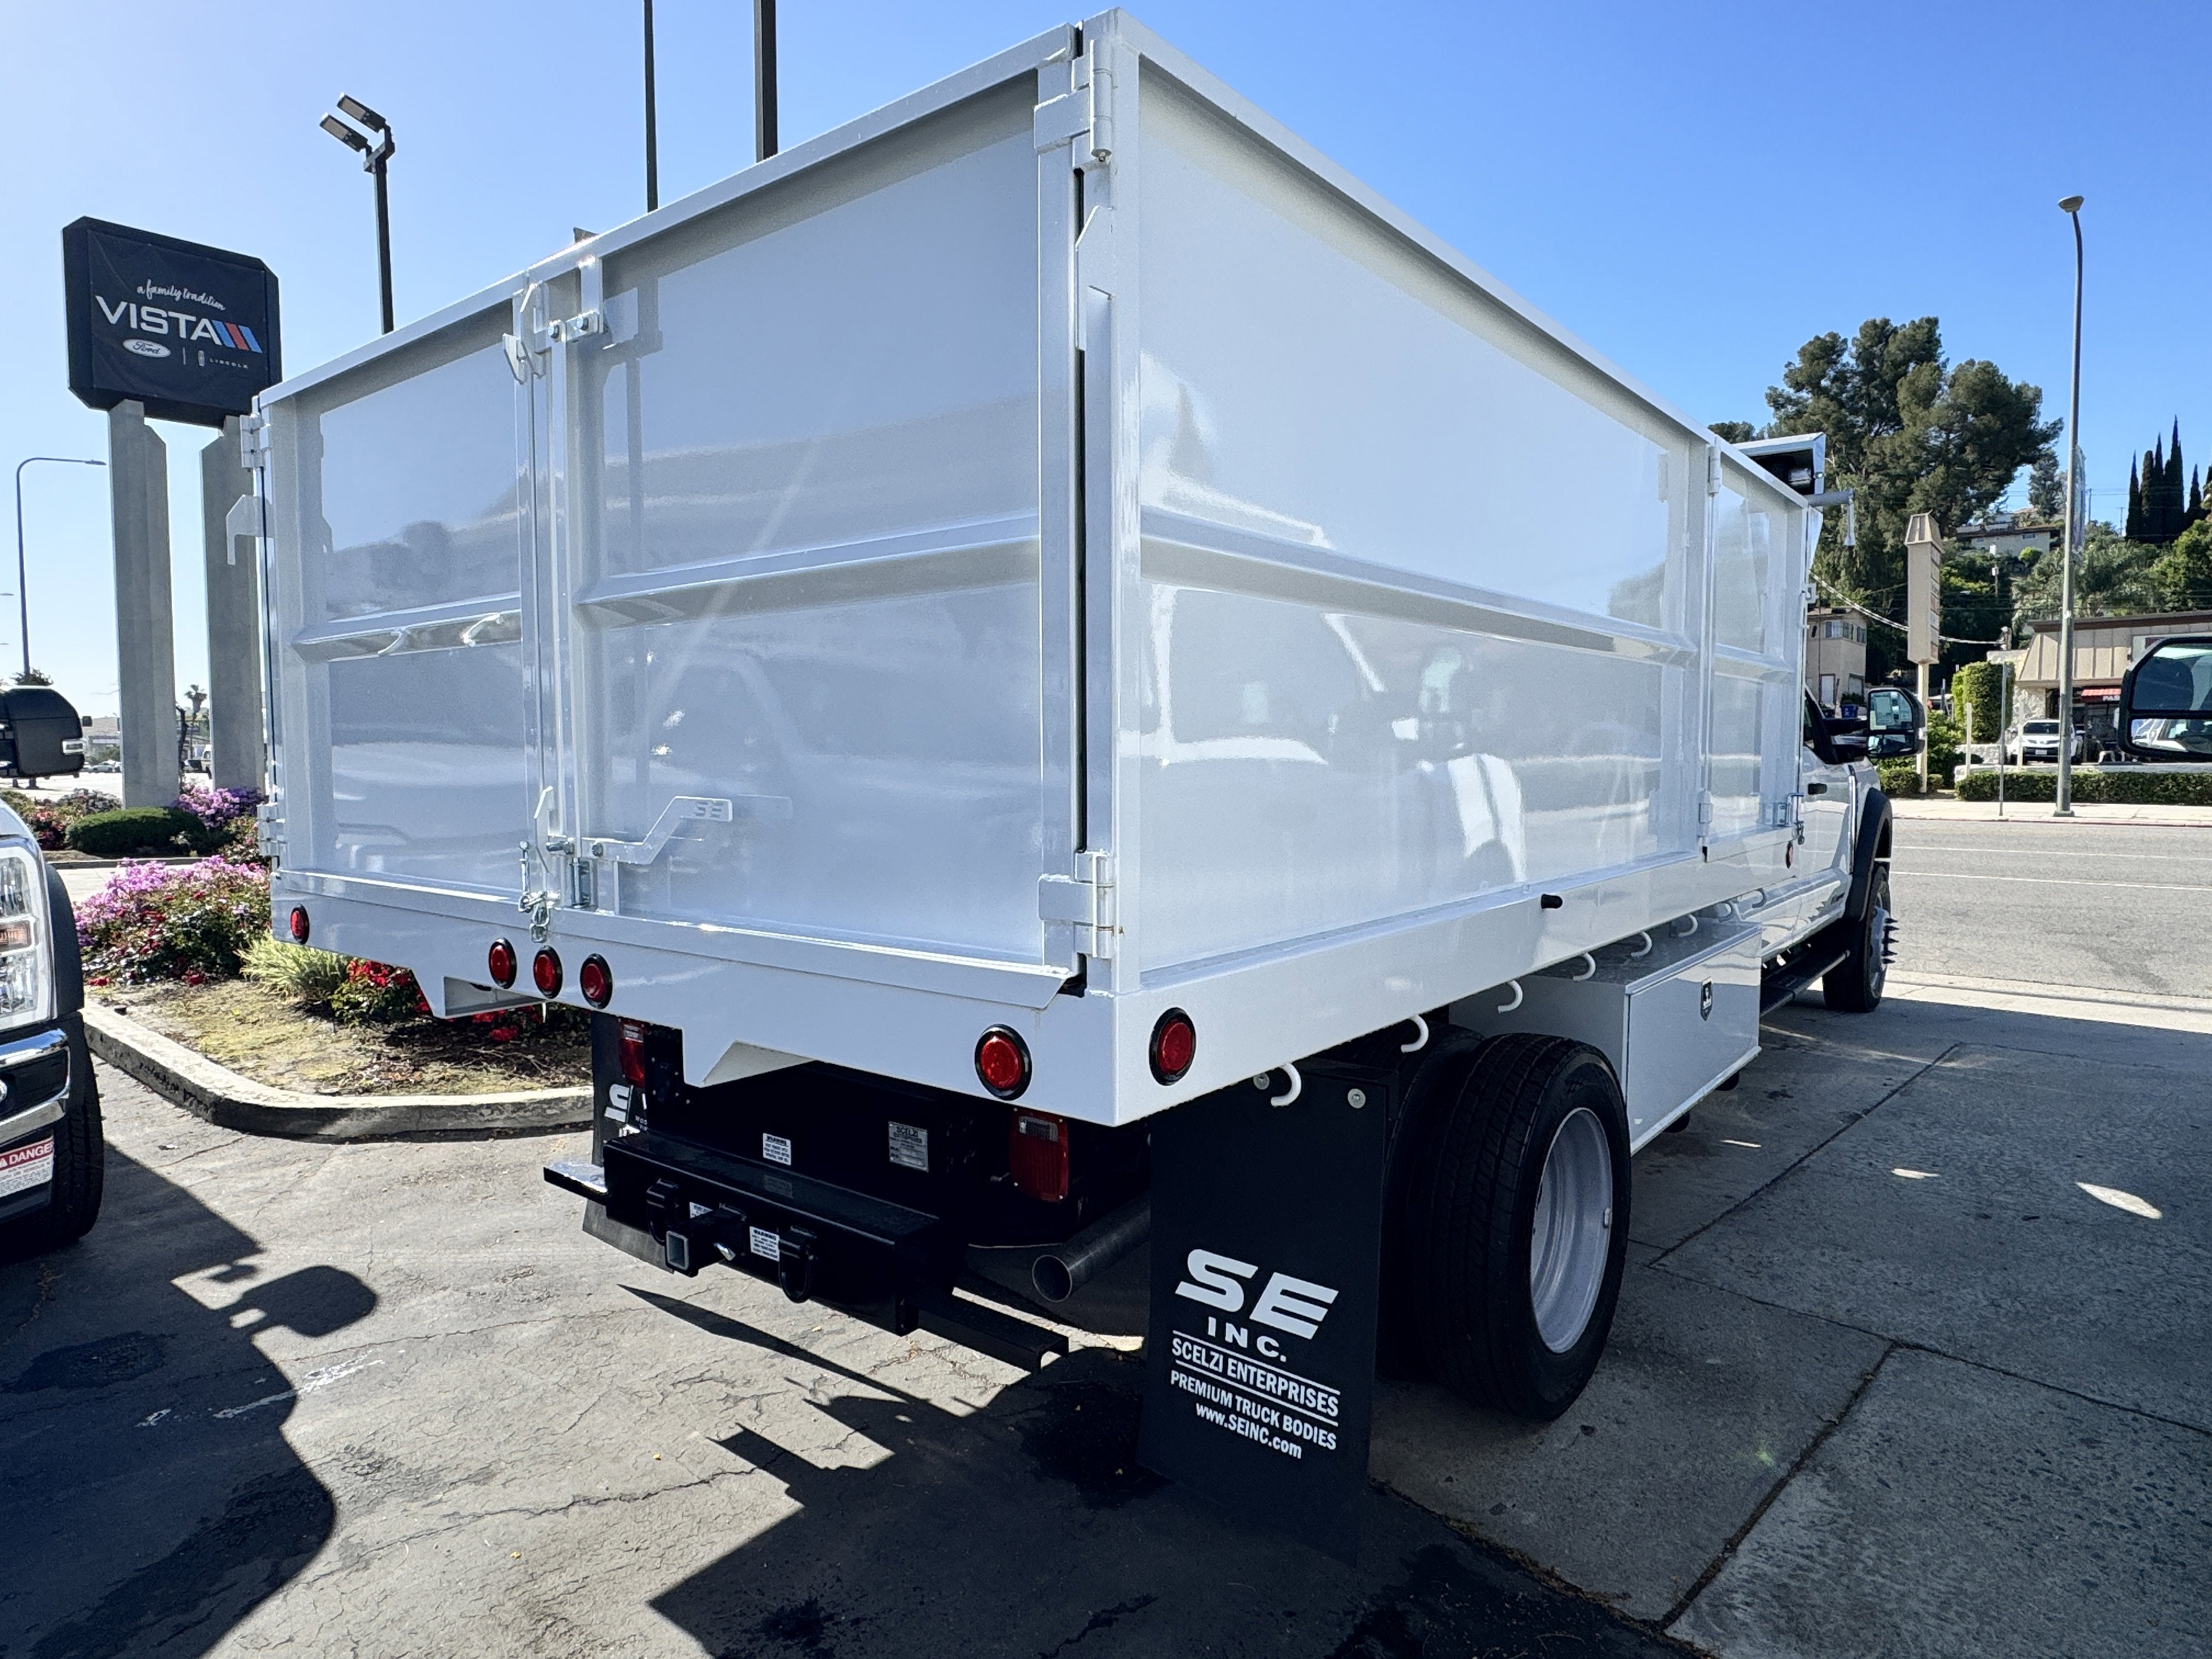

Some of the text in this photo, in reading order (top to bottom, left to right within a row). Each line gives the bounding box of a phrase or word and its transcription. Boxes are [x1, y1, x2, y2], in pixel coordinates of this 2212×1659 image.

[95, 295, 223, 346] VISTA
[137, 279, 226, 311] a family tradition
[133, 342, 161, 354] Ford
[1175, 1249, 1339, 1340] SE
[1207, 1316, 1286, 1362] INC.
[1172, 1338, 1339, 1417] SCELZI ENTERPRISES
[1170, 1369, 1337, 1451] PREMIUM TRUCK BODIES
[1195, 1402, 1302, 1459] www.SEINC.com
